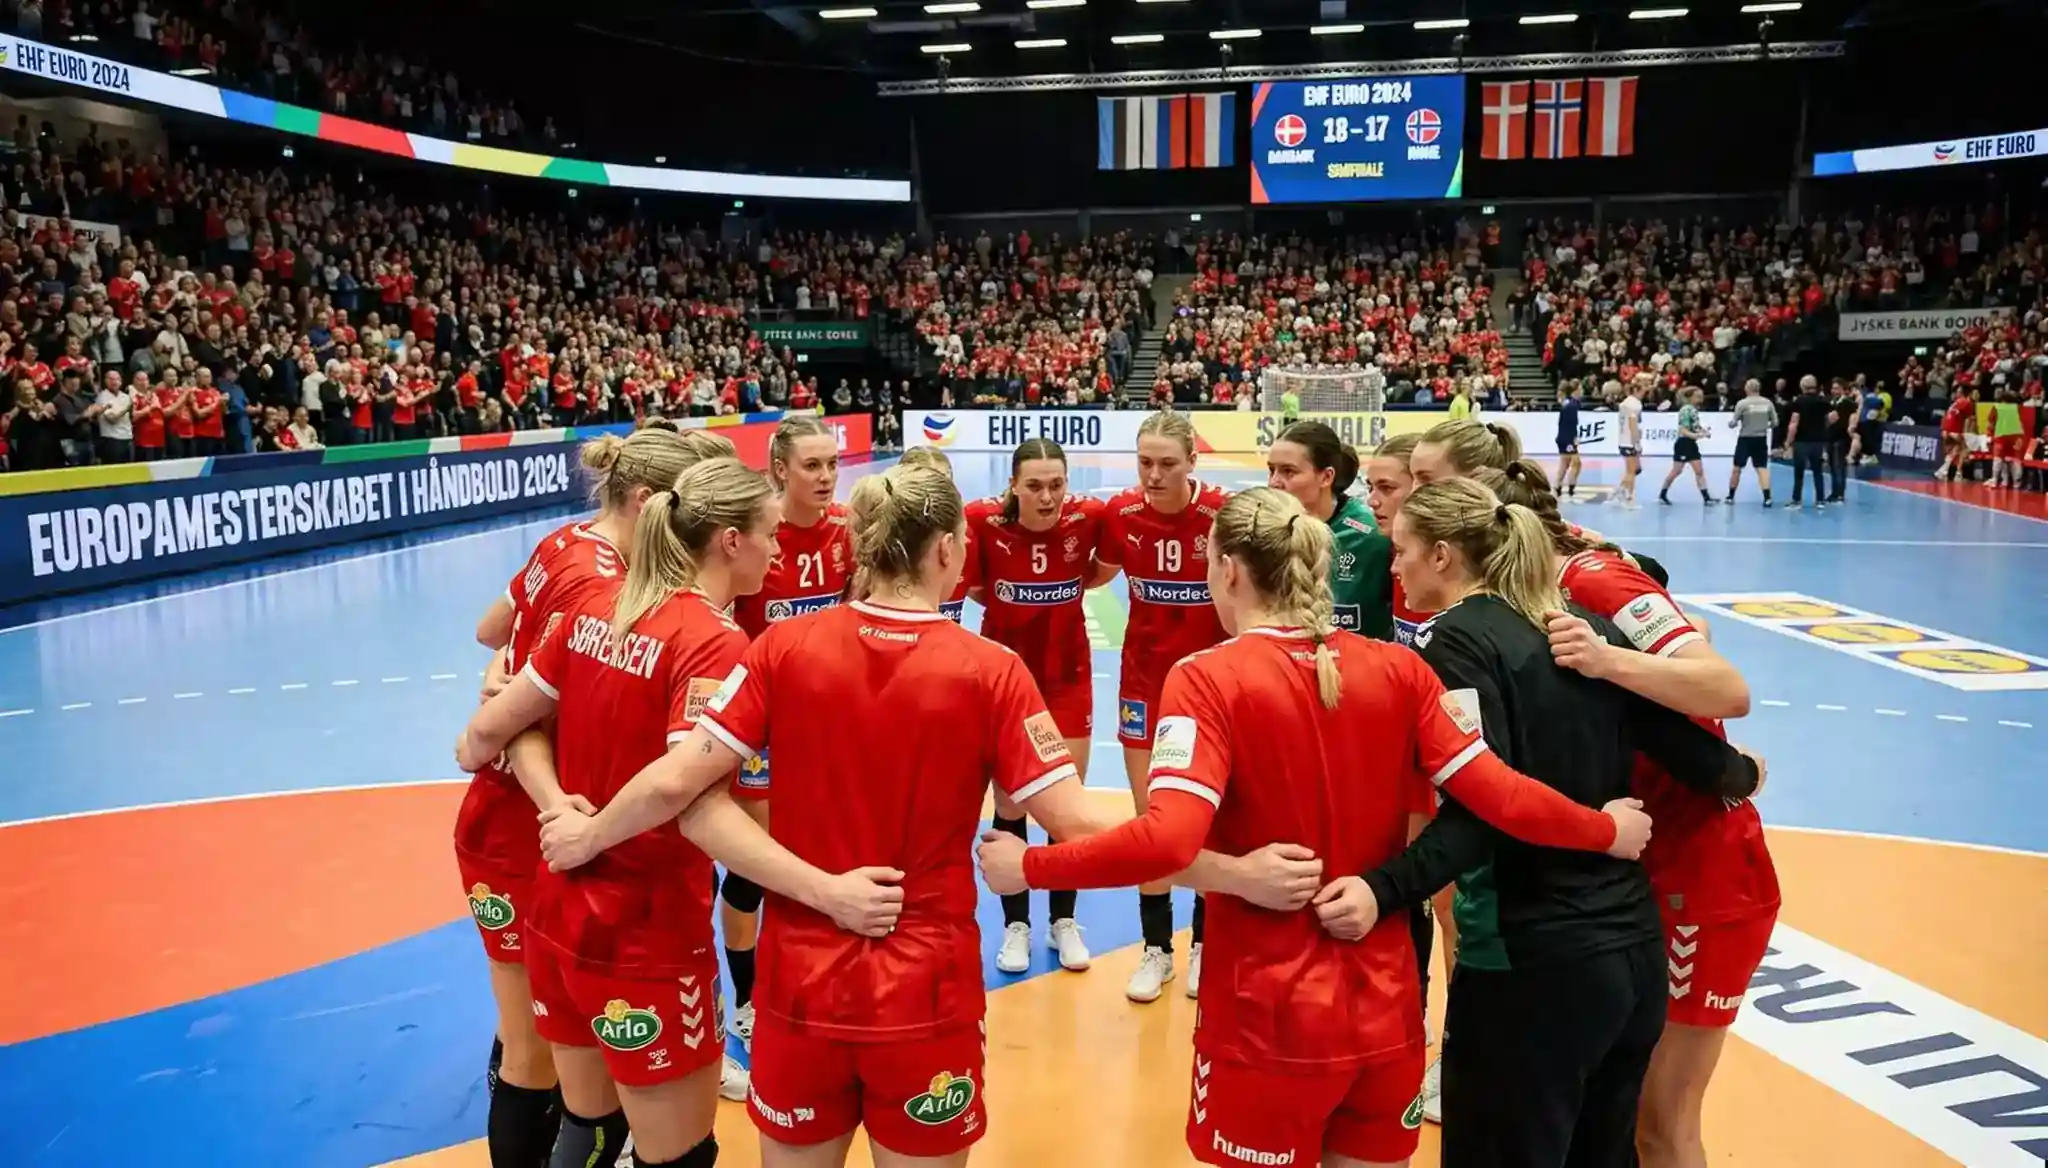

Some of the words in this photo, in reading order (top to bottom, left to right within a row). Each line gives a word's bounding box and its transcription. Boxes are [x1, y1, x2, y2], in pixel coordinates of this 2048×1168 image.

[17, 43, 45, 72] EHF
[48, 51, 87, 81] EURO
[1332, 83, 1370, 105] EURO
[1371, 81, 1412, 103] 2024
[1966, 140, 1992, 158] EHF
[1996, 135, 2036, 156] EURO
[1899, 317, 1940, 330] BANK
[988, 415, 1030, 446] EHF
[1040, 415, 1101, 446] EURO
[27, 472, 393, 577] EUROPAMESTERSKABET
[398, 471, 409, 516] I
[411, 456, 519, 514] HÅNDBOLD
[523, 453, 570, 498] 2024
[797, 551, 825, 588] 21
[1031, 544, 1048, 575] 5
[1154, 539, 1182, 573] 19
[601, 1018, 648, 1039] Arla
